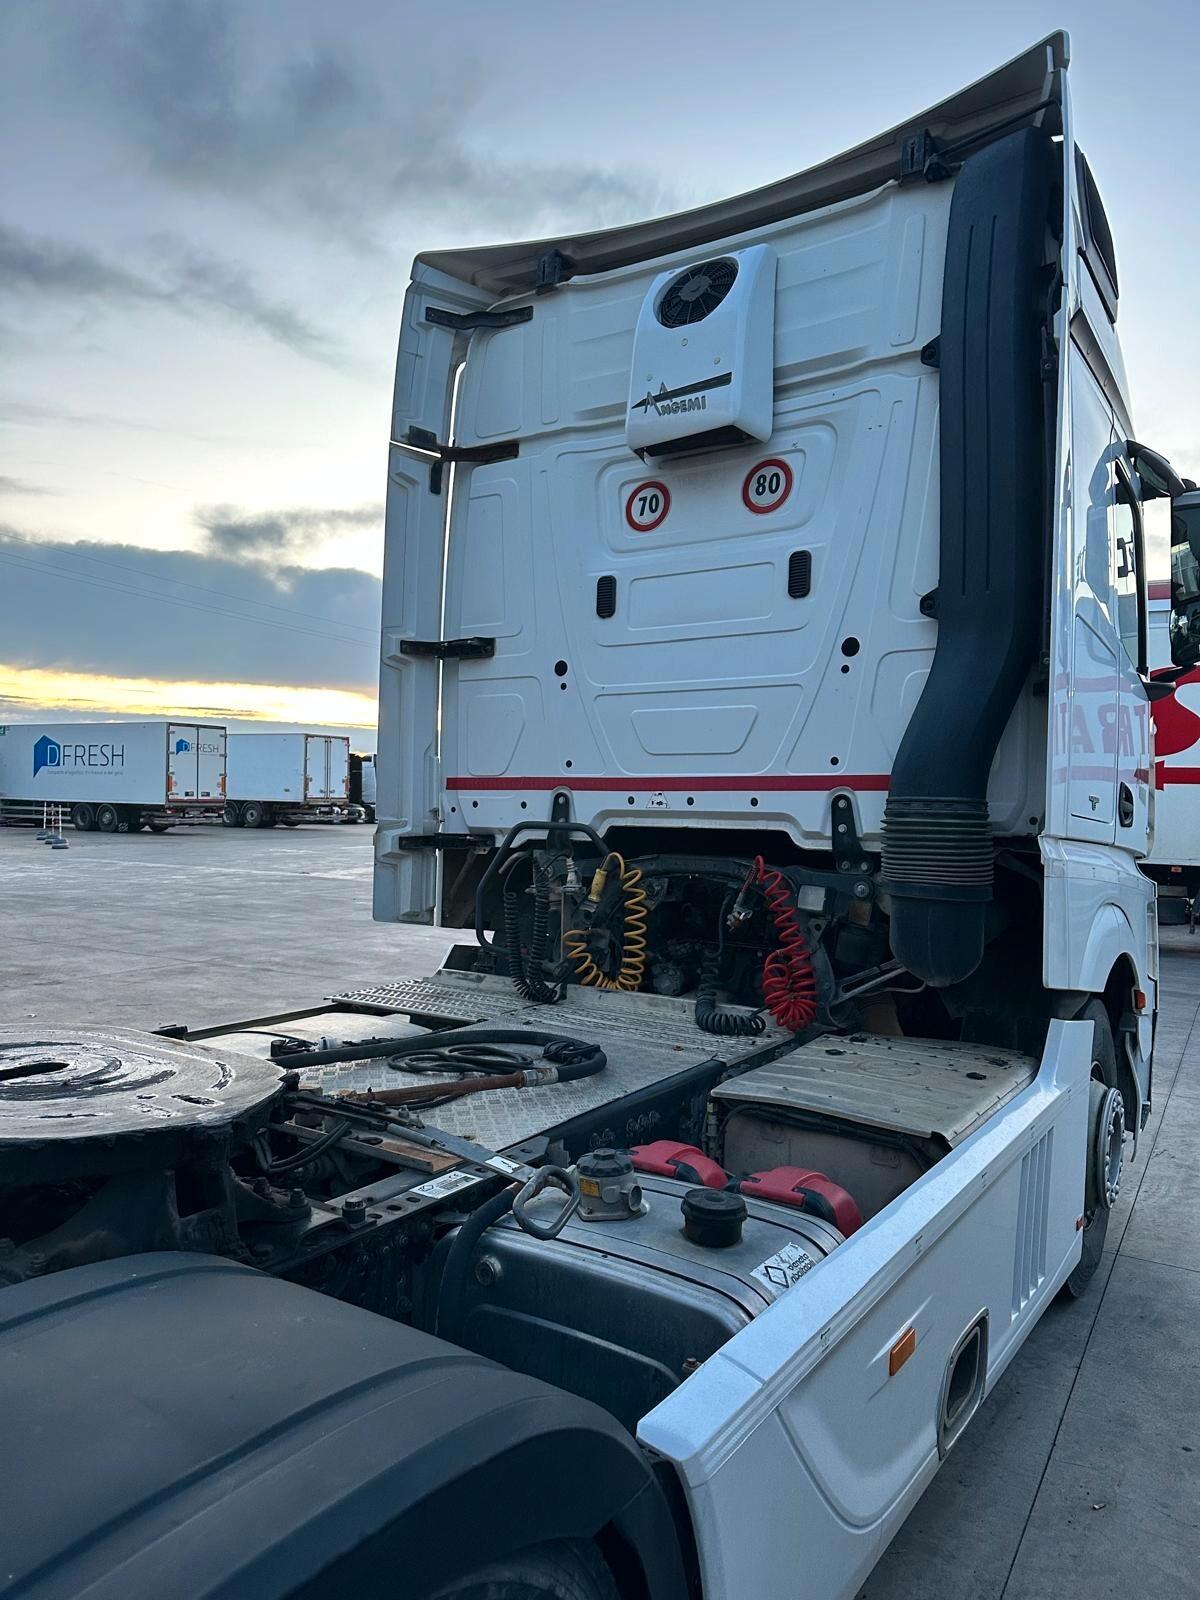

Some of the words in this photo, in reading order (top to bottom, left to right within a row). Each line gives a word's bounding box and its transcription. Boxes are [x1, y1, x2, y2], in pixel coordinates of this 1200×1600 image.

[643, 389, 707, 417] ANGEMI
[755, 472, 781, 496] 80
[638, 494, 660, 516] 70
[47, 744, 125, 766] DFRESH
